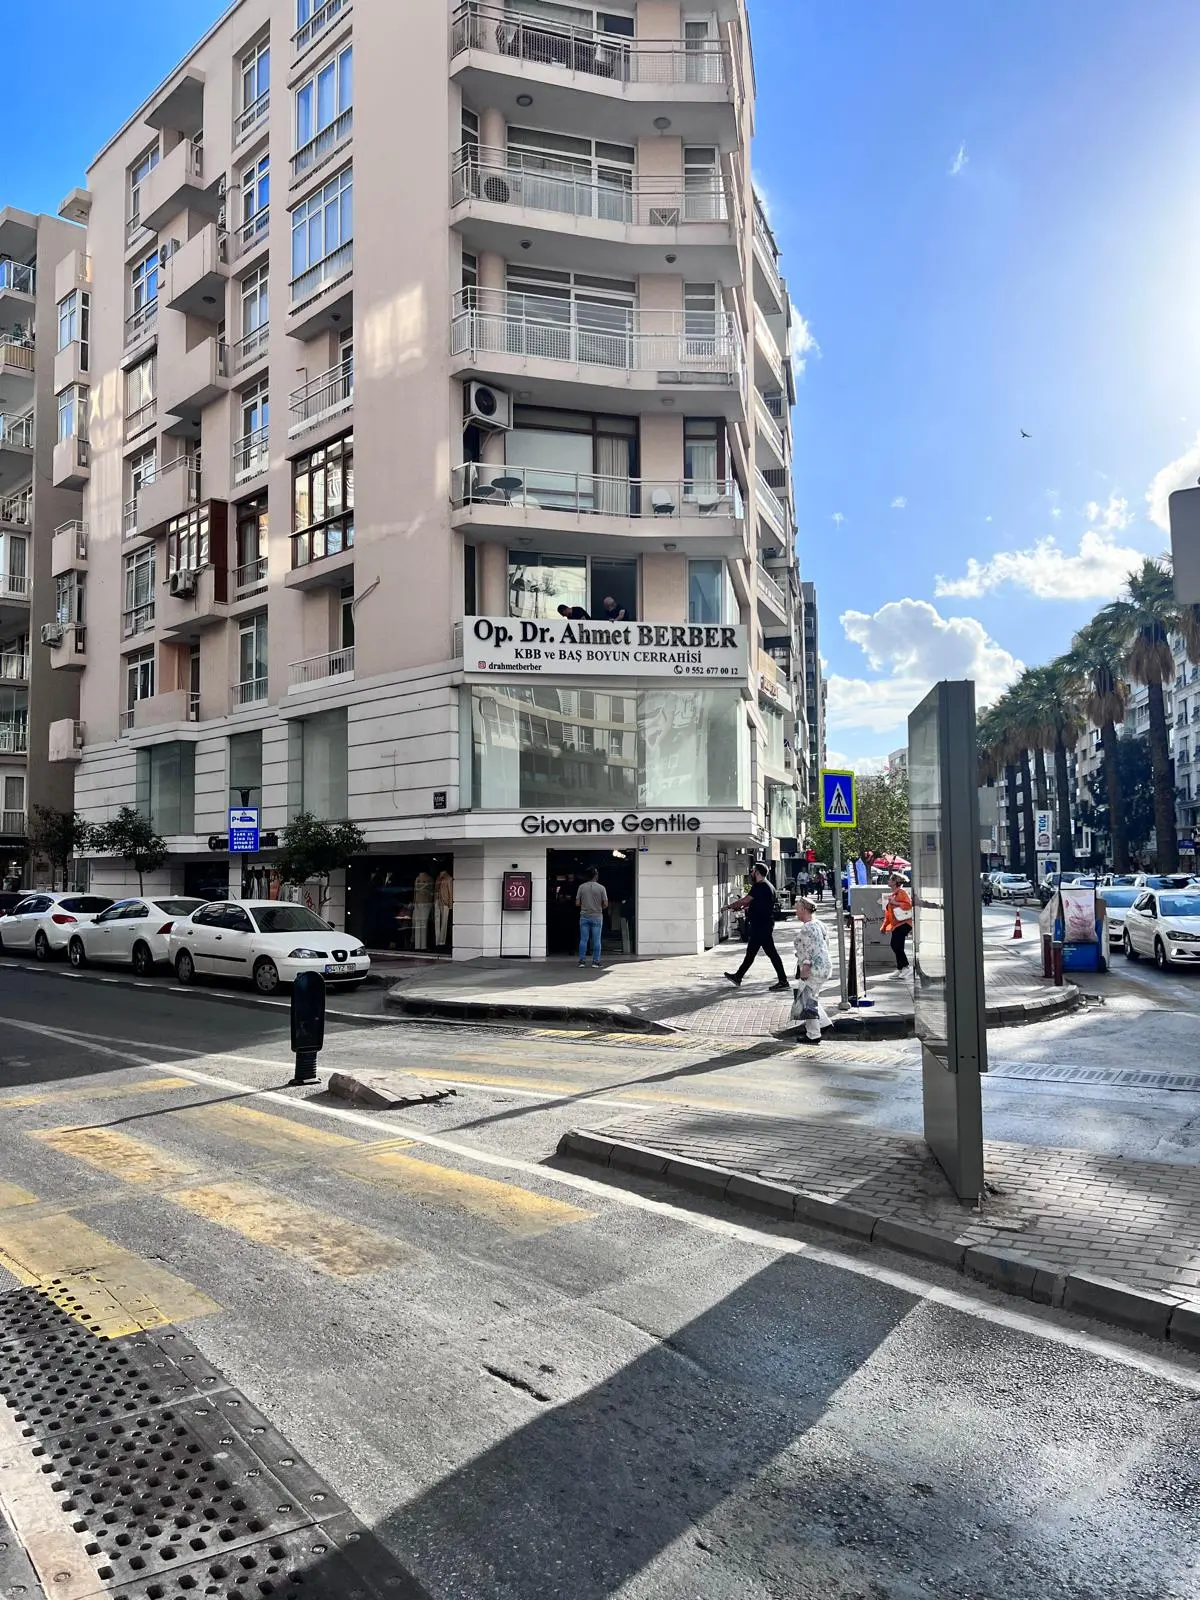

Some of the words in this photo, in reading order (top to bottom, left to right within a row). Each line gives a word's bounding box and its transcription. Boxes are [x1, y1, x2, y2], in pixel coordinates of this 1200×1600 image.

[474, 619, 513, 647] Op.
[520, 621, 555, 643] Dr.
[560, 623, 631, 645] Ahmet
[637, 625, 738, 648] BERBER
[514, 648, 541, 660] KBB
[544, 652, 556, 660] ve
[559, 649, 582, 662] BAŞ
[587, 650, 629, 661] BOYUN
[633, 650, 702, 663] CERRAHİSİ
[488, 662, 542, 671] drahmetberber
[691, 666, 704, 674] 552
[706, 667, 718, 675] 677
[720, 667, 729, 675] 00
[730, 667, 738, 675] 12
[520, 815, 615, 834] Giovane
[621, 814, 700, 832] Gentile
[1038, 814, 1046, 833] TEOL
[509, 885, 525, 897] 30
